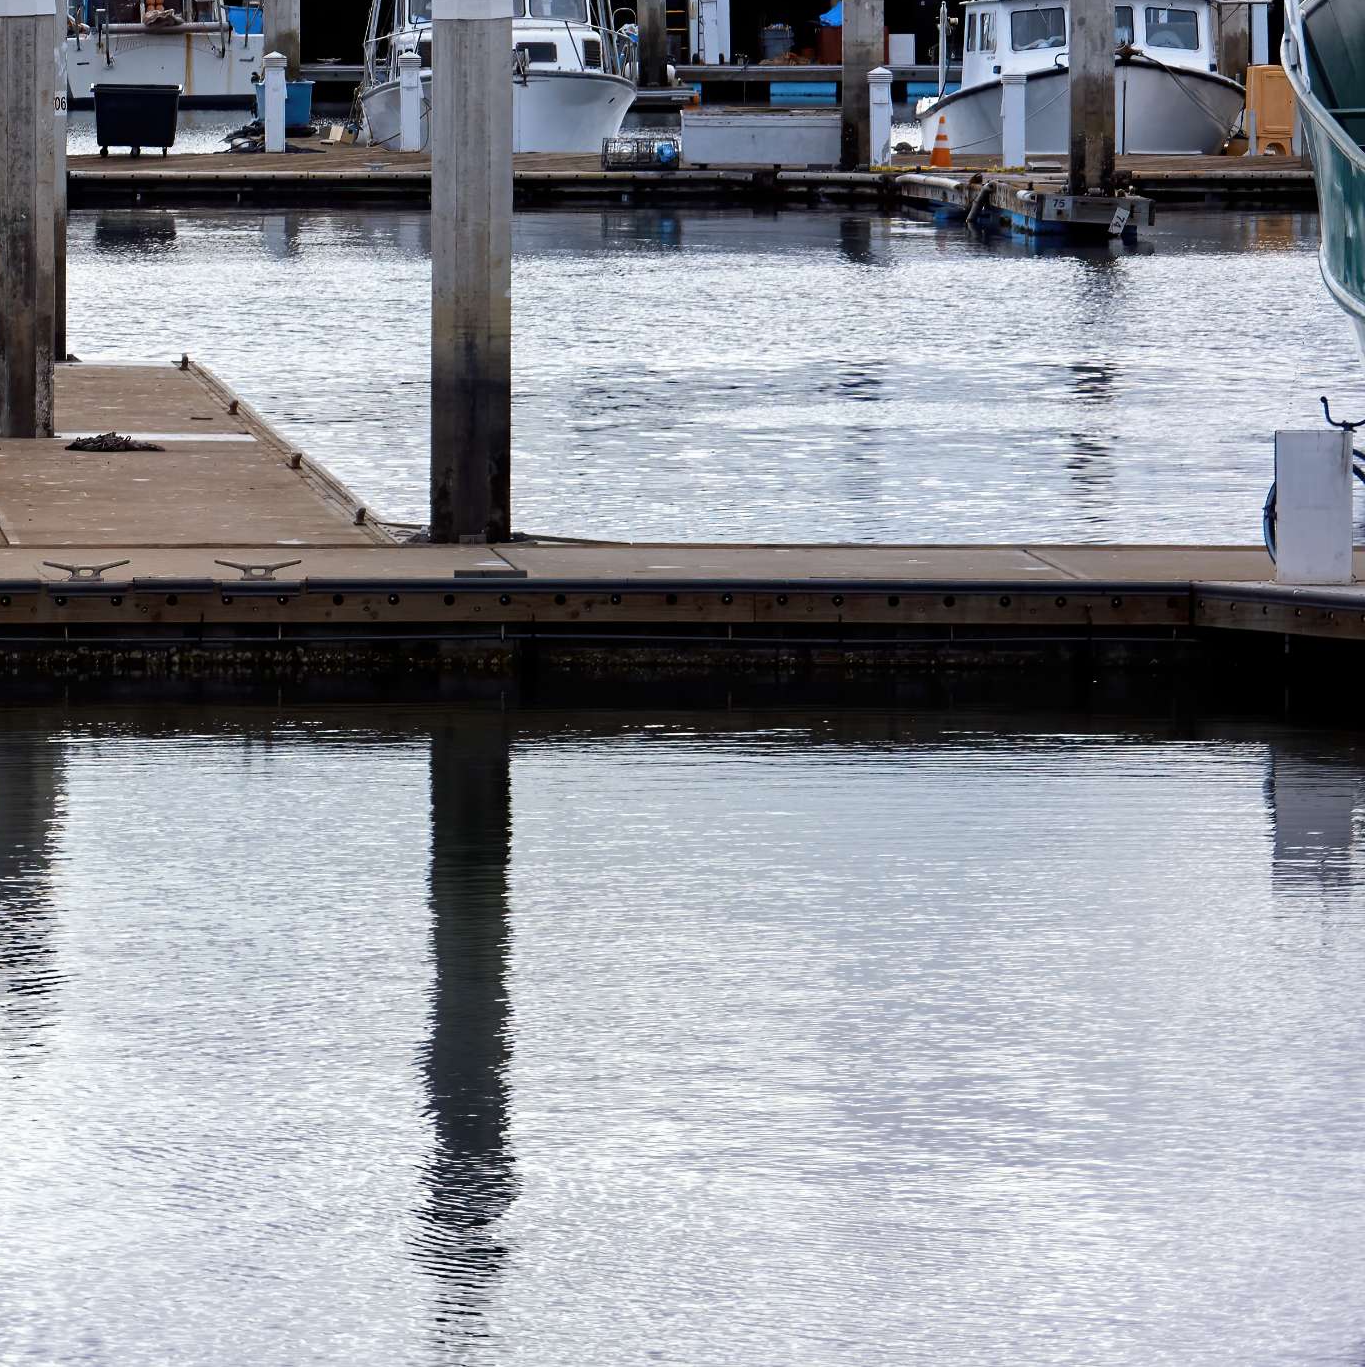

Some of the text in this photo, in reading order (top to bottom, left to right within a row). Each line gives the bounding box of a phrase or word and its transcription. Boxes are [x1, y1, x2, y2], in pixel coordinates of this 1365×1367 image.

[54, 96, 67, 111] 06
[1052, 198, 1066, 209] 75
[1112, 214, 1126, 230] 74
